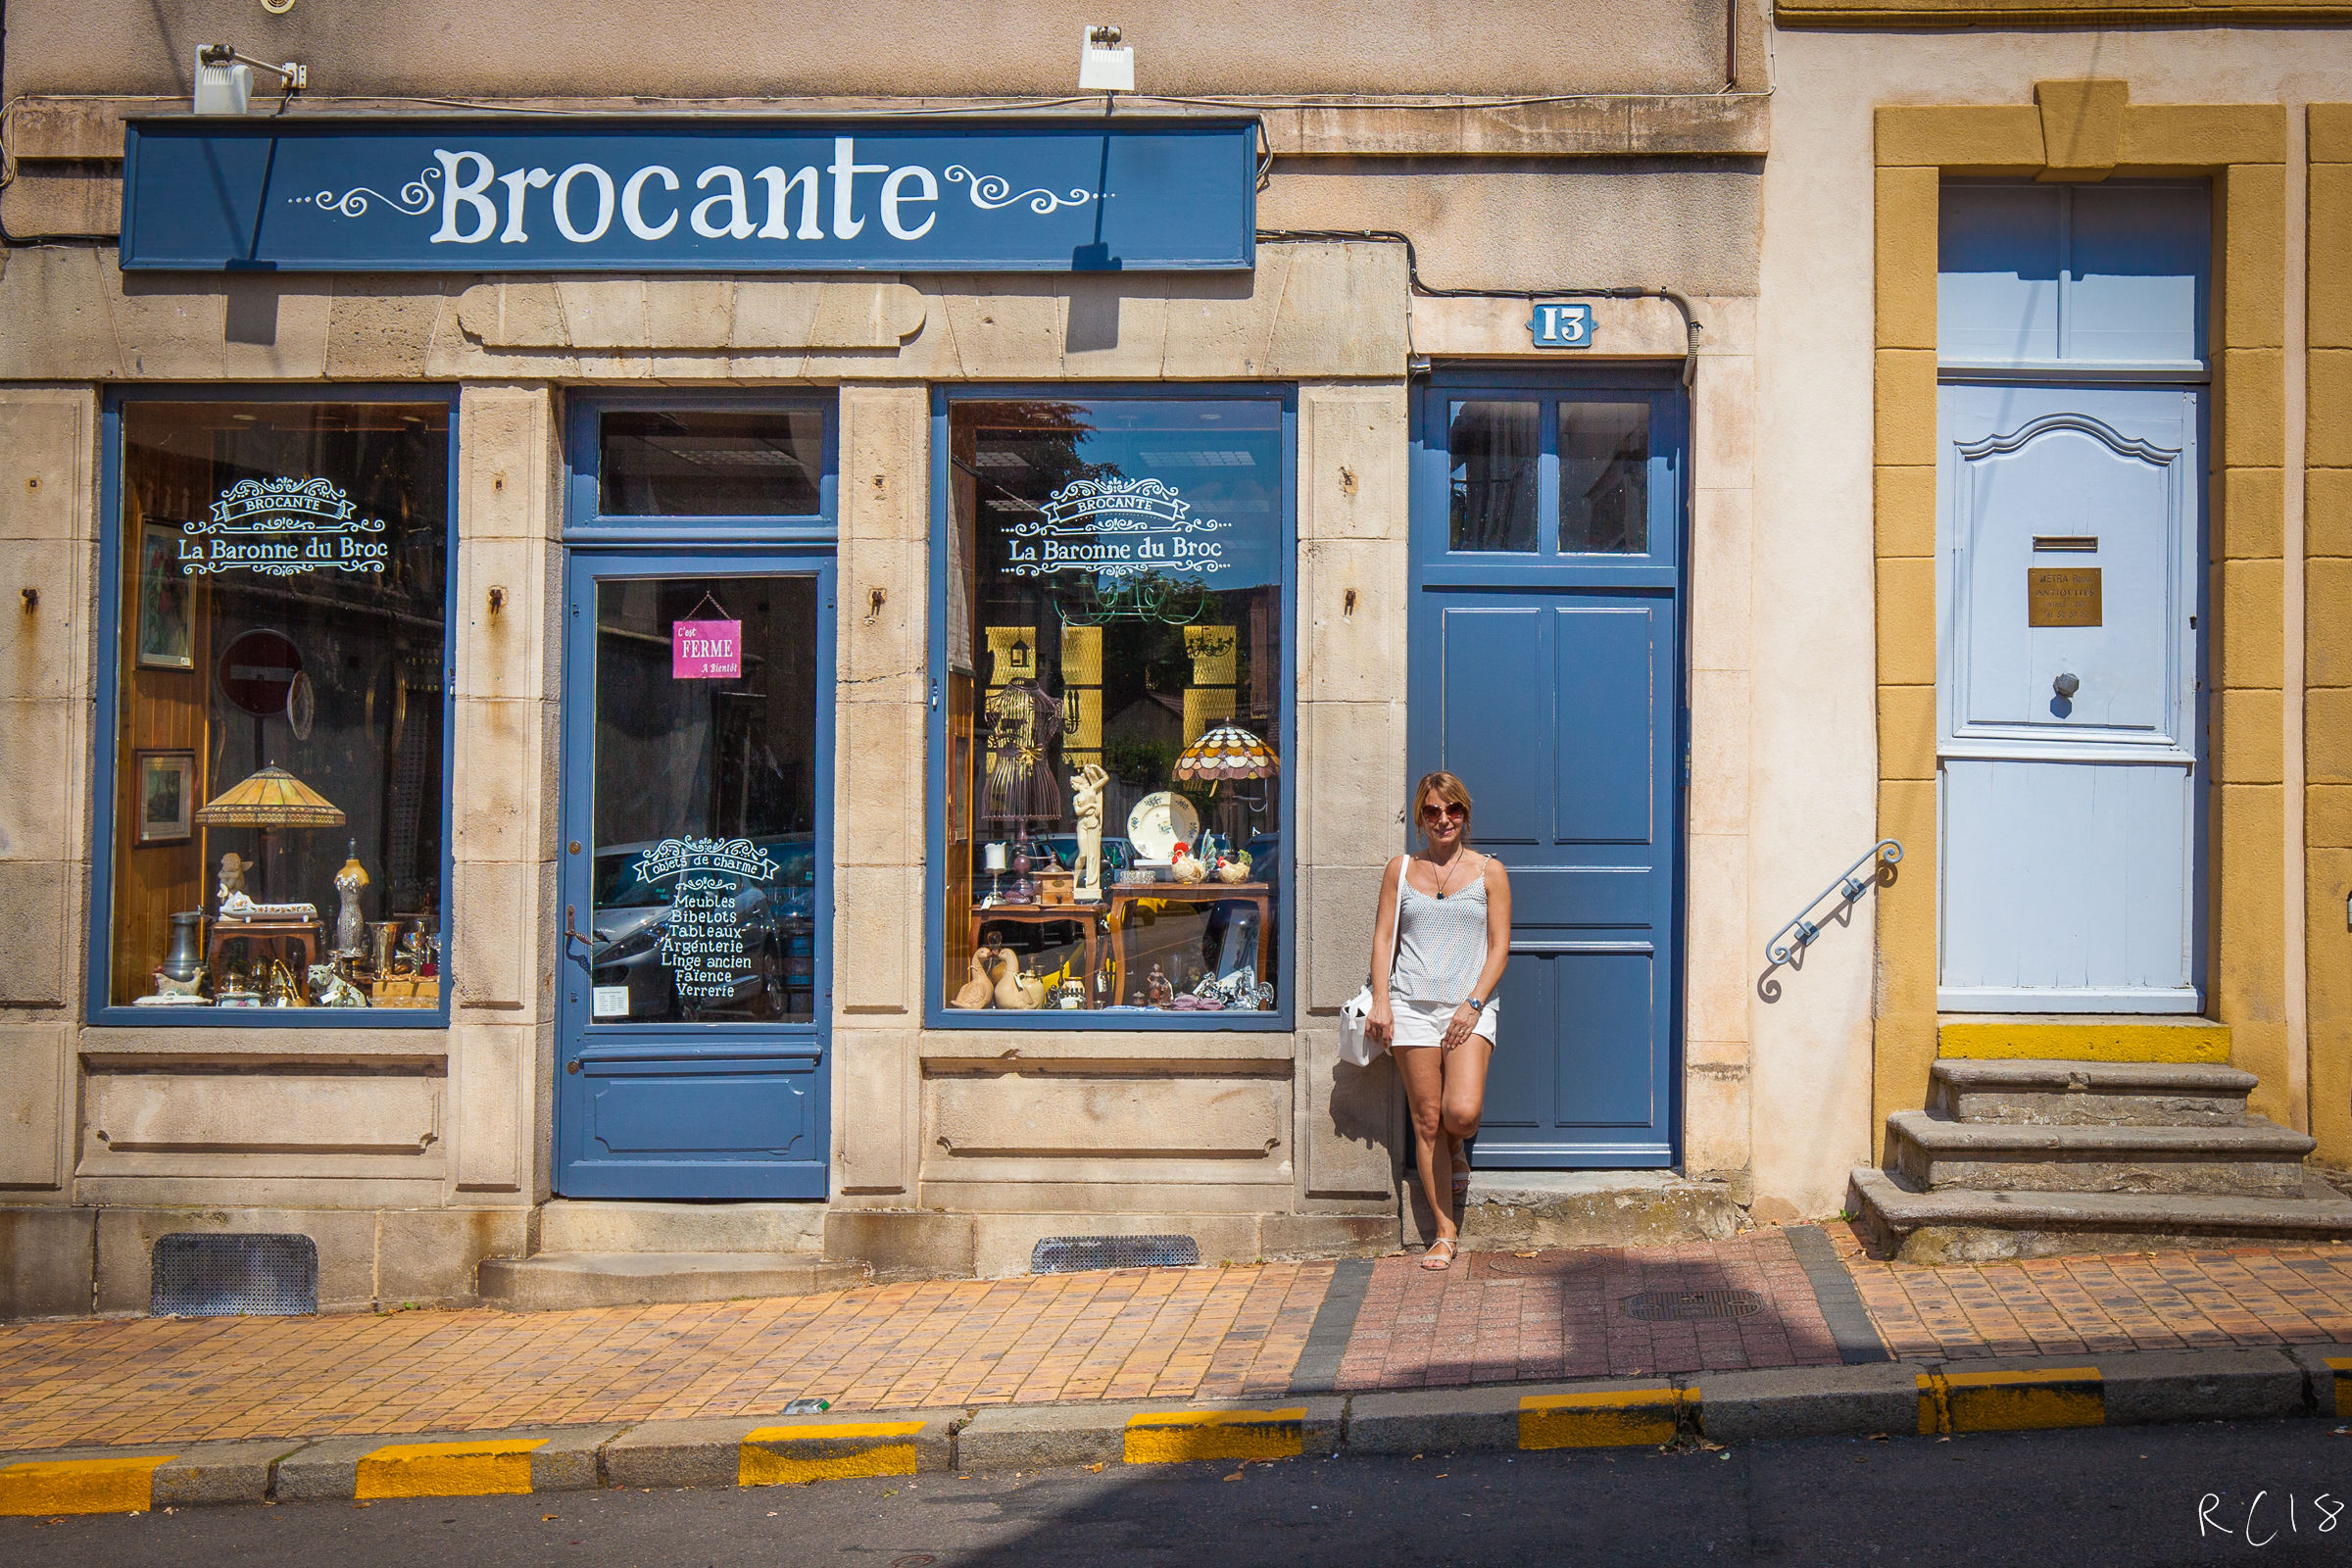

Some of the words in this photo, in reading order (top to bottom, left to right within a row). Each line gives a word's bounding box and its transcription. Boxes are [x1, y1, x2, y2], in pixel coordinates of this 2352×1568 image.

[429, 135, 938, 244] Brocante
[1543, 308, 1584, 341] 13
[245, 496, 320, 512] BROCANTE
[1077, 497, 1152, 513] BROCANTE
[178, 538, 204, 560] La
[210, 538, 299, 560] Baronne
[305, 536, 332, 559] du
[340, 536, 388, 559] Broc
[1008, 539, 1038, 562] La
[1043, 539, 1131, 561] Baronne
[1137, 536, 1165, 559] du
[1172, 536, 1222, 558] Broc
[677, 626, 697, 637] C'est
[682, 639, 733, 659] FERME
[693, 856, 710, 866] de
[713, 856, 758, 875] charme
[673, 895, 736, 908] Meubles
[670, 910, 737, 923] Bibelots
[668, 925, 743, 939] Tableaux
[661, 953, 701, 970] Linge
[707, 956, 752, 968] ancien
[674, 970, 732, 983] Faïence
[675, 983, 735, 998] Verrerie
